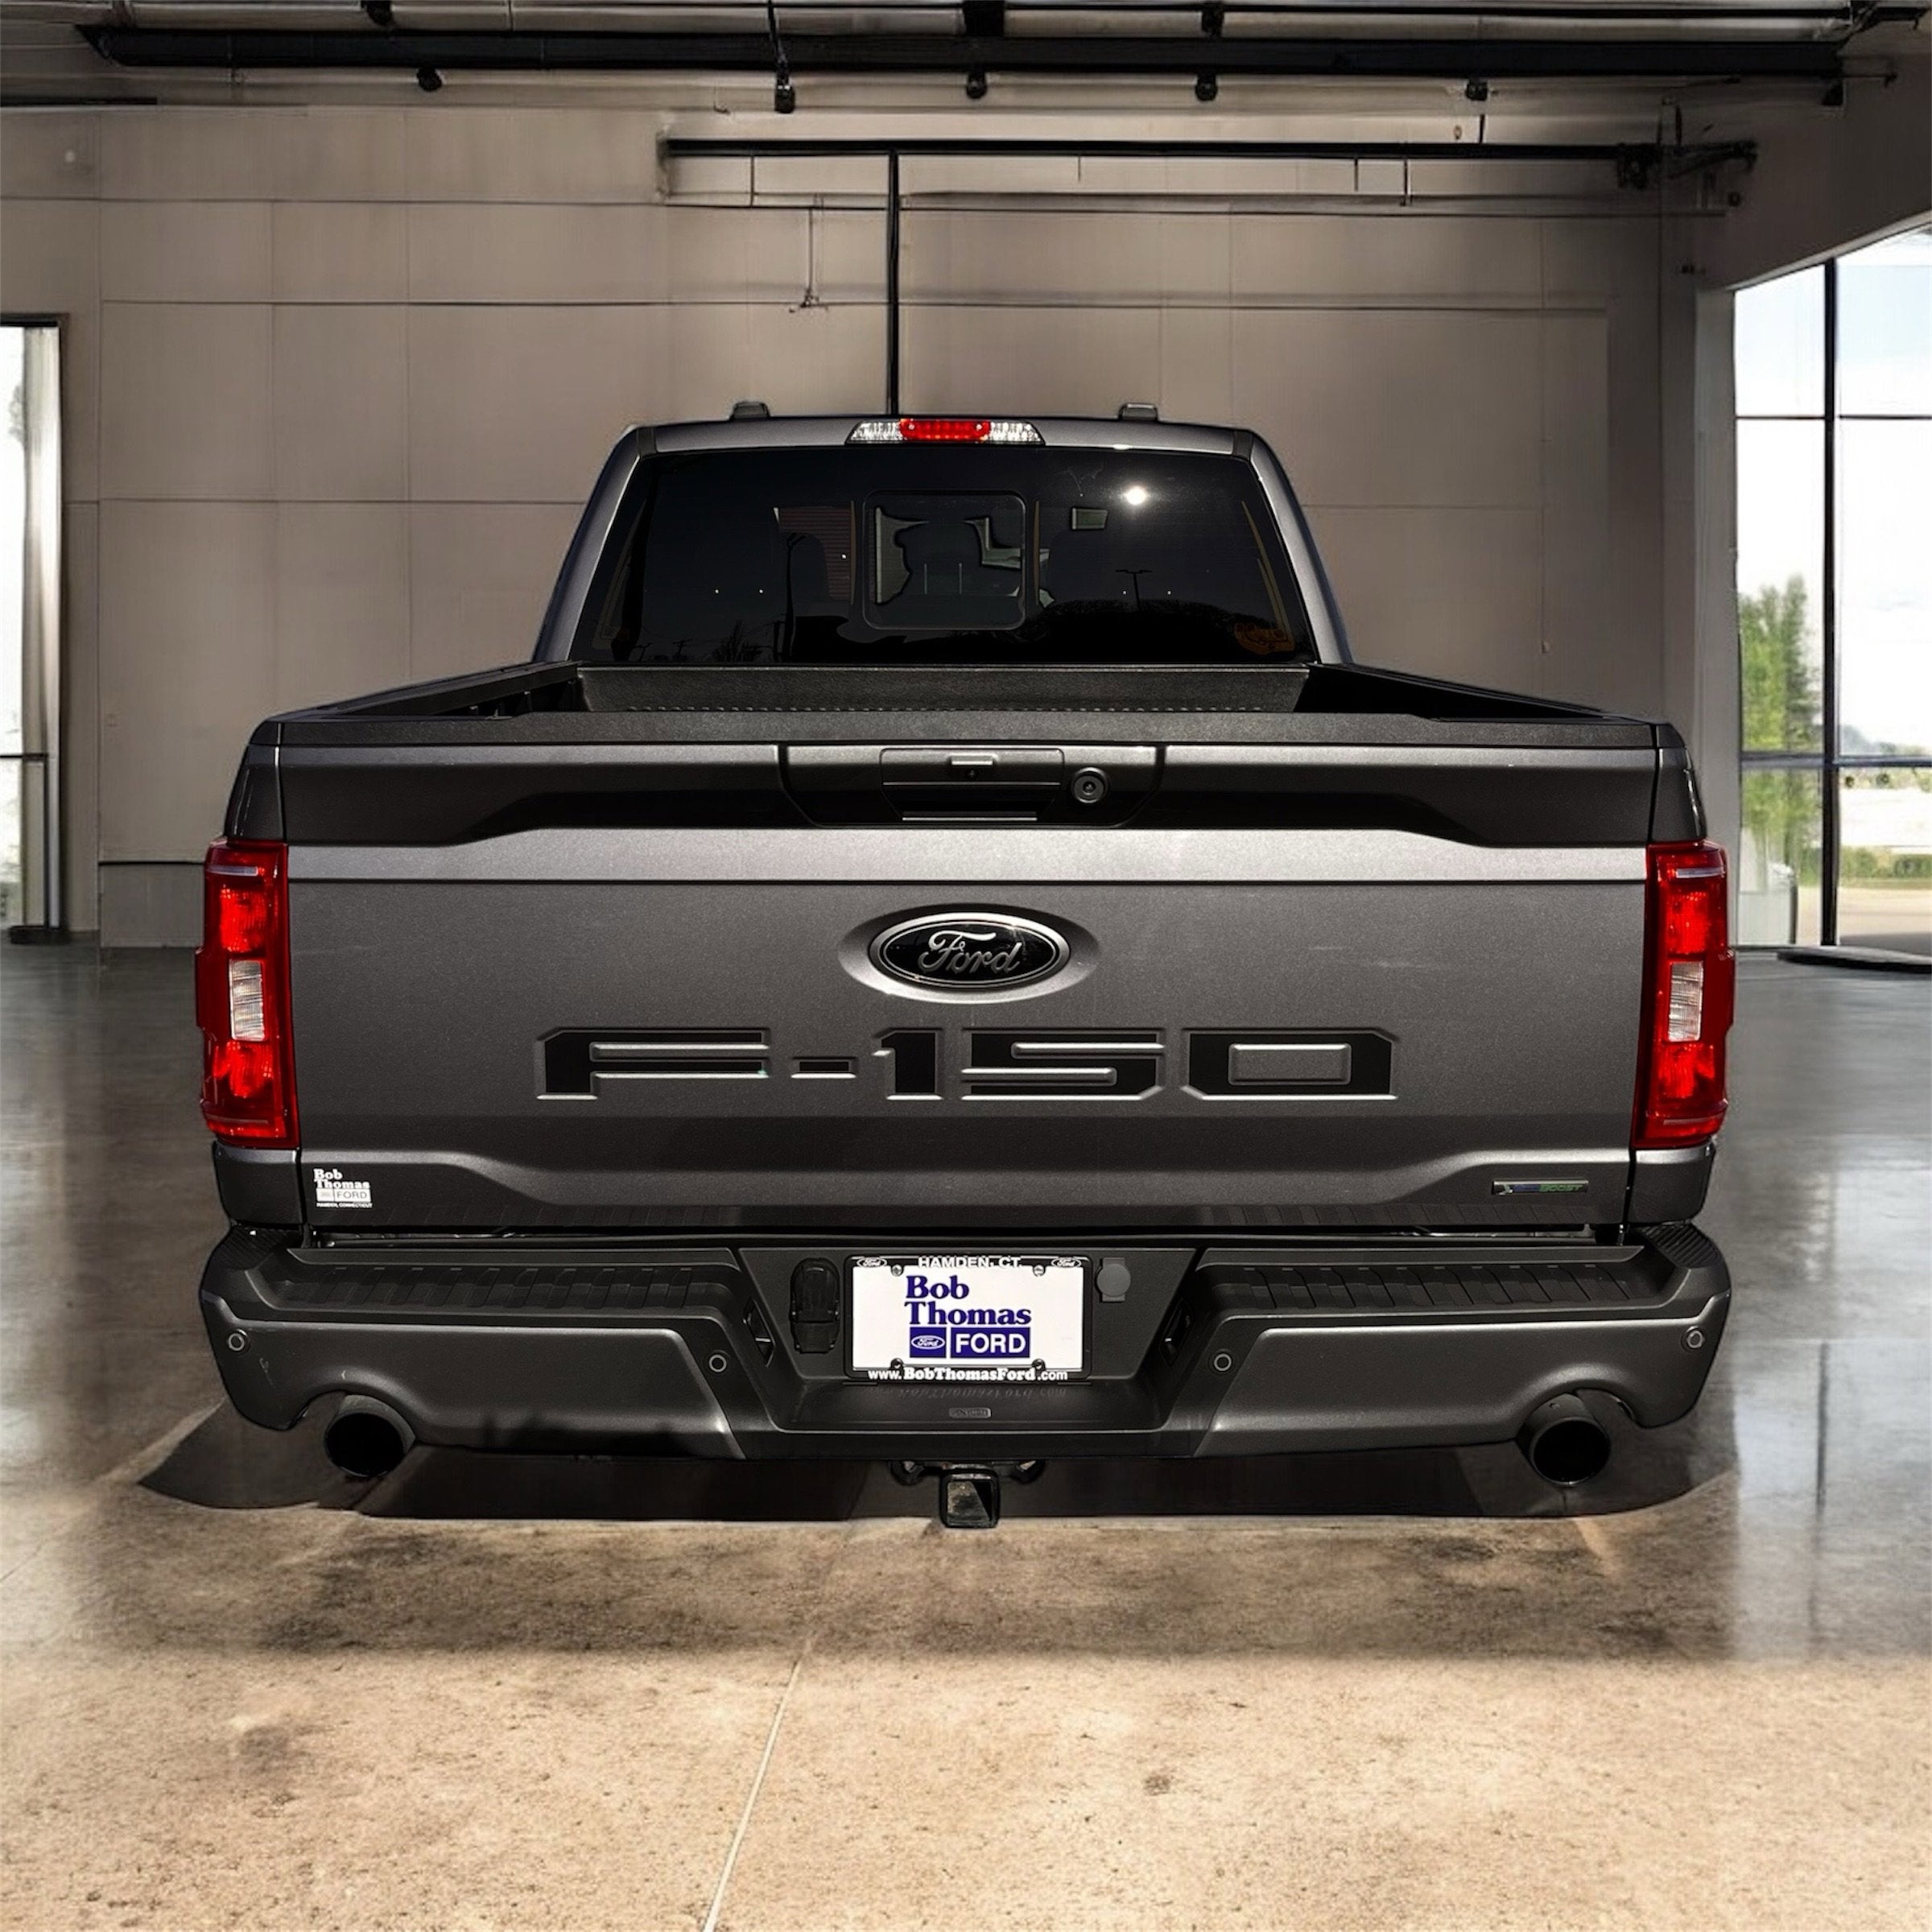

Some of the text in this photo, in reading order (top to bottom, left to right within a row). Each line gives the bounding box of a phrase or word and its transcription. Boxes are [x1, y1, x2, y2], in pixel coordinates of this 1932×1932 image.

[918, 930, 1023, 974] Ford
[537, 1027, 1398, 1100] F-150
[313, 1168, 343, 1180] Bob
[314, 1179, 370, 1189] Thomas
[906, 1275, 970, 1298] Bob
[904, 1301, 1032, 1325] Thomas
[916, 1333, 1026, 1353] Ford FORD
[867, 1368, 1068, 1381] www.BobThomasFord.com
